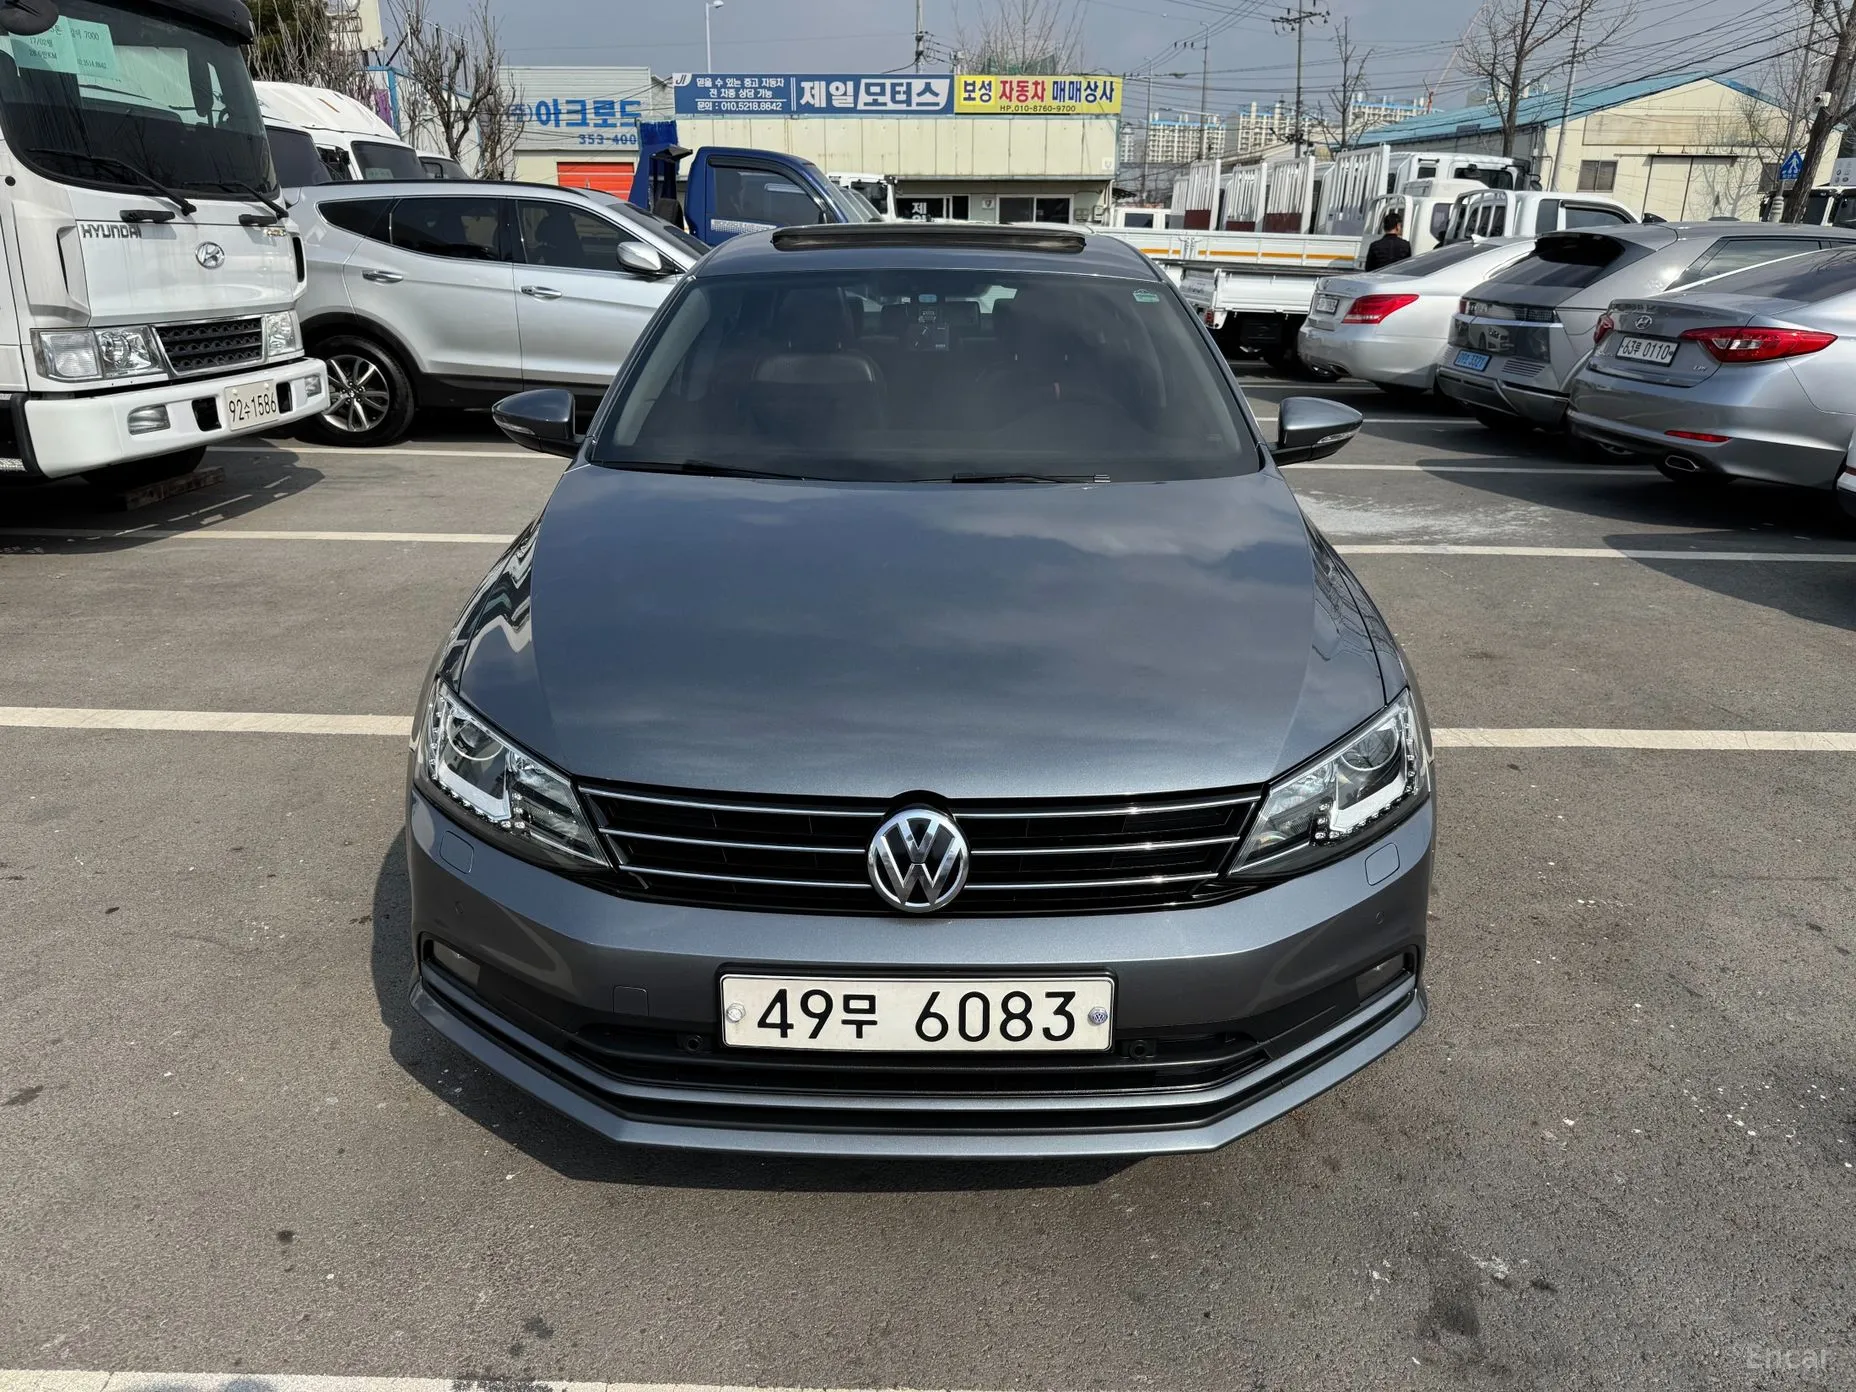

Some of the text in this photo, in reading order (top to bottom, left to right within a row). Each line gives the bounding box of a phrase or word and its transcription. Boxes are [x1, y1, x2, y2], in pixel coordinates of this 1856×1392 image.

[696, 77, 784, 87] 믿을 수 있는 중고 자동차
[709, 88, 773, 98] 전 차종 상담 가능
[963, 80, 1115, 104] 보성 자동차 매매상사
[697, 101, 713, 111] 문의
[82, 224, 142, 239] HYUNDAI
[1643, 342, 1671, 360] 0110
[757, 988, 1076, 1043] 49무 6083
